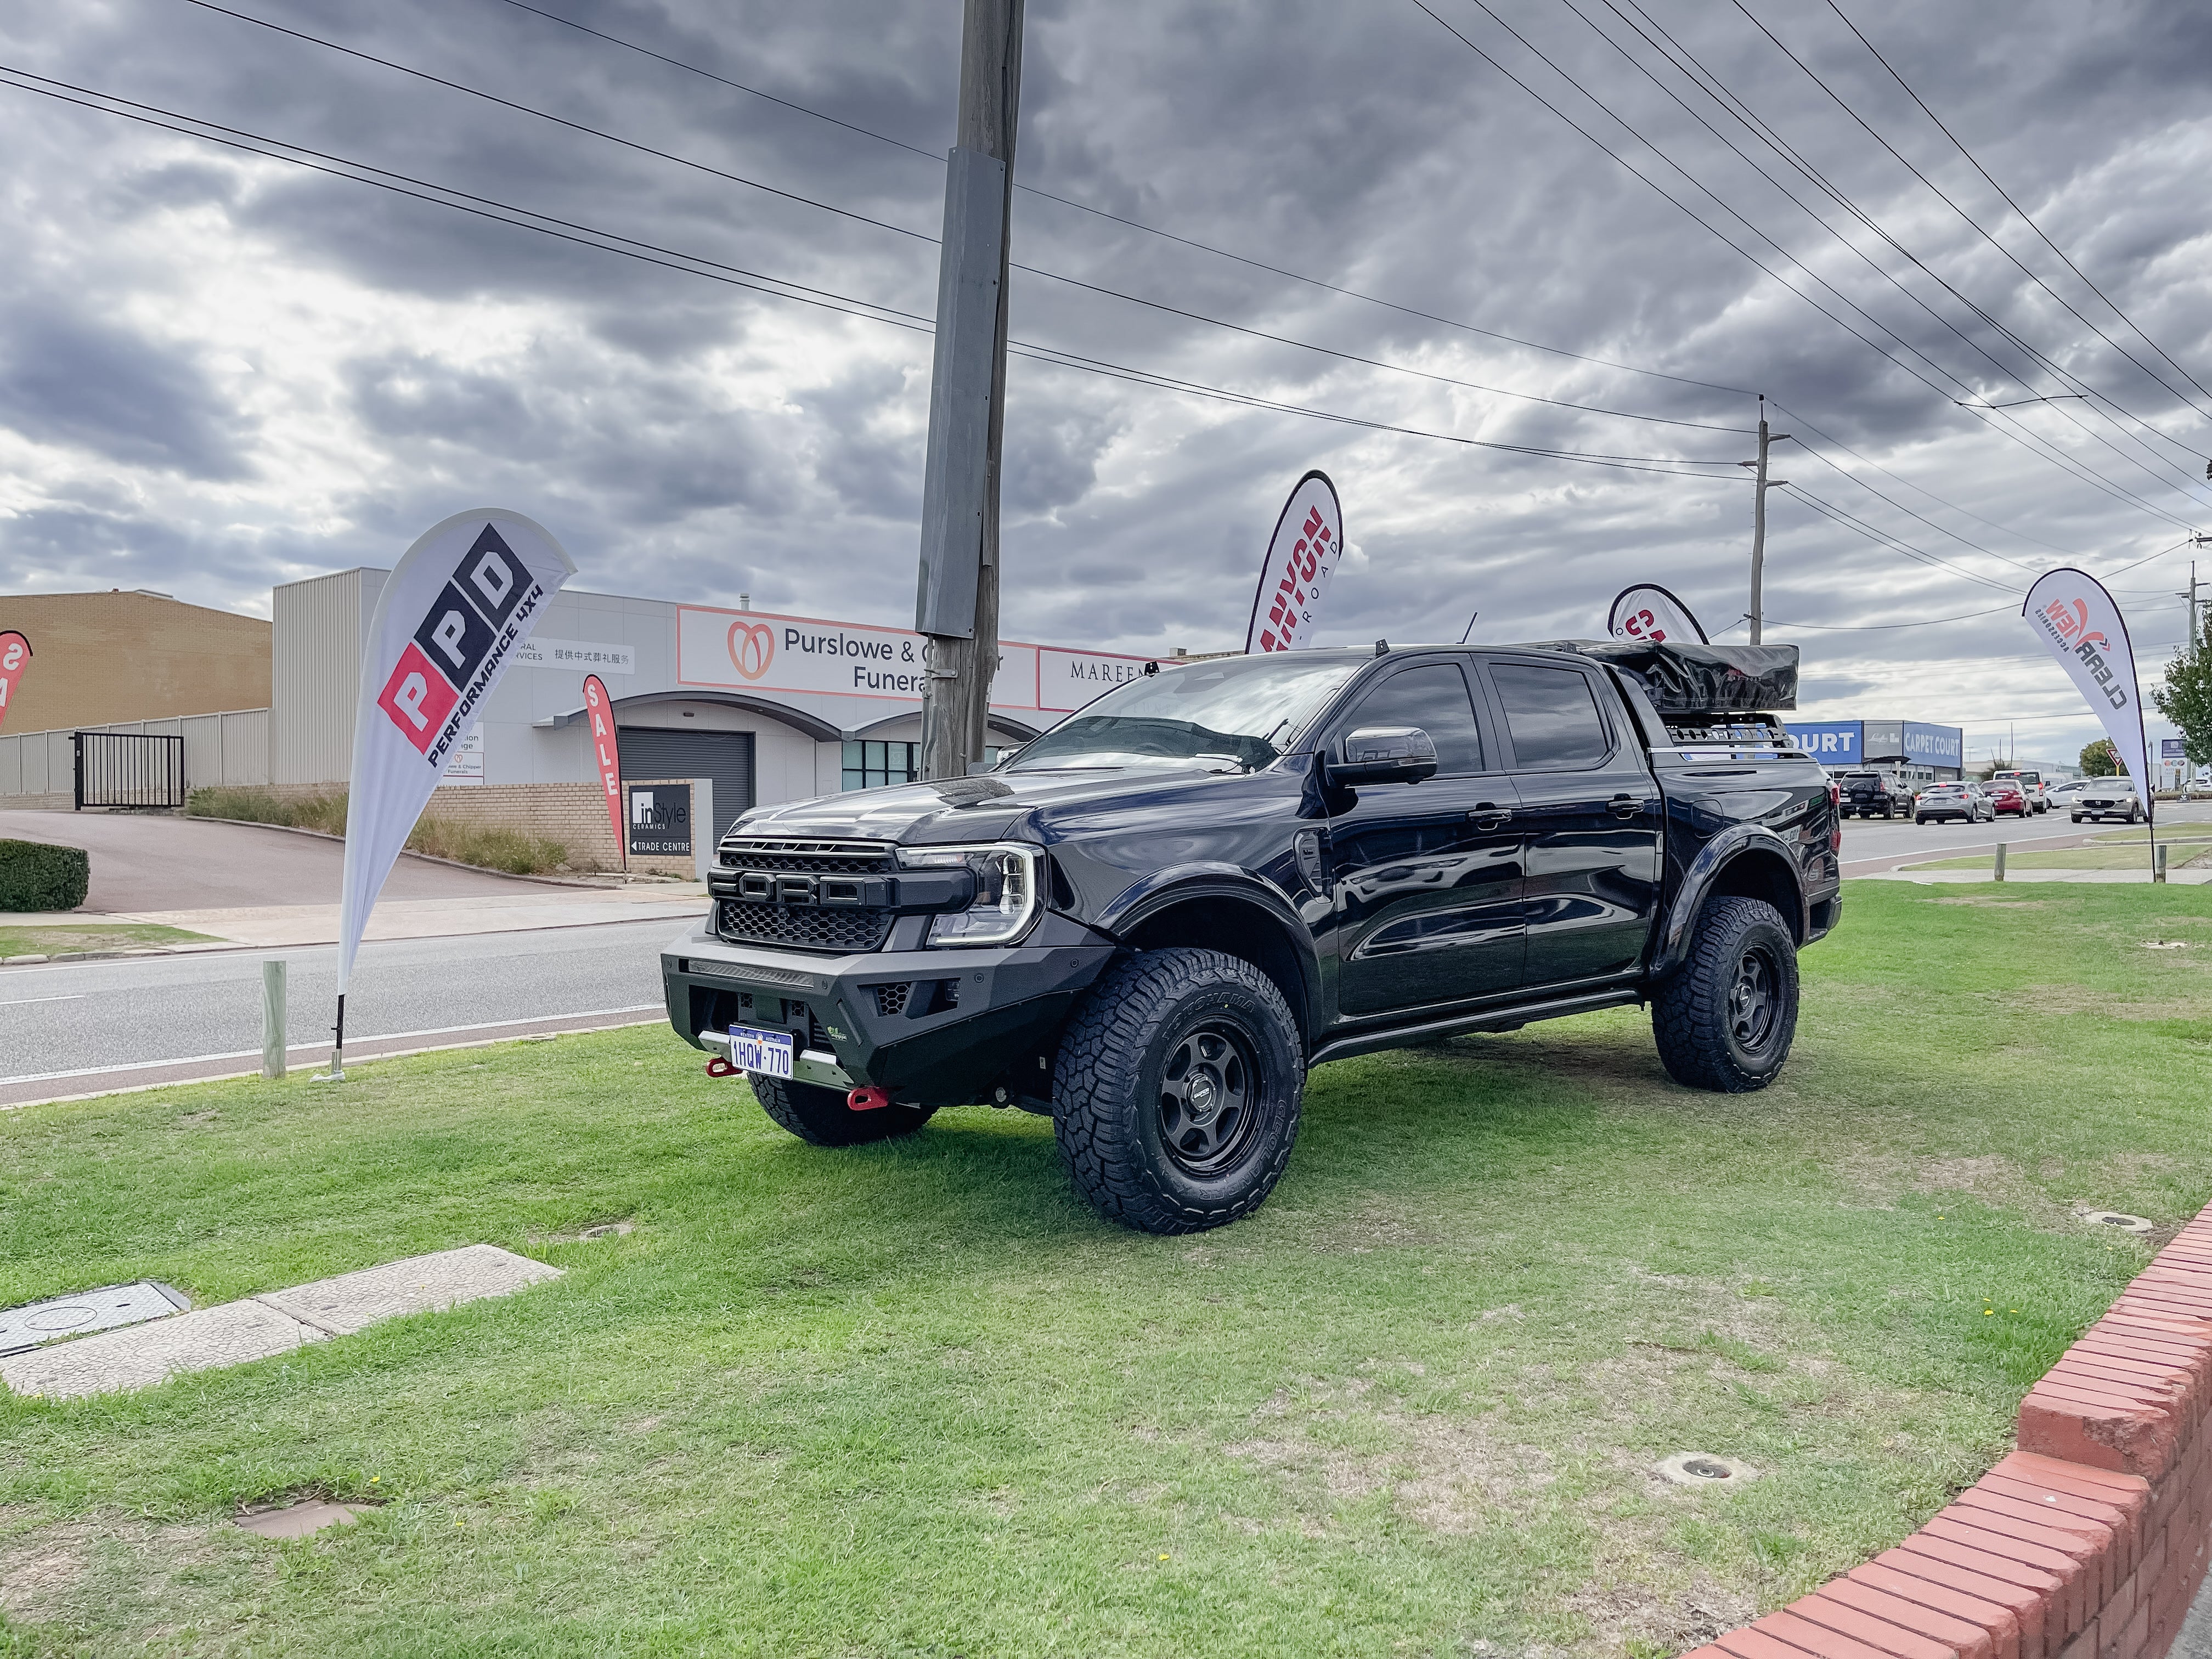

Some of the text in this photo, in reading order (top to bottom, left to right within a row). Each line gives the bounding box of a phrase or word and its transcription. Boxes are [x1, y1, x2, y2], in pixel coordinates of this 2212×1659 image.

[1260, 504, 1331, 652] ANYON
[393, 551, 514, 732] PPD
[428, 623, 518, 768] PERFORMANCE
[785, 628, 893, 661] Purslowe
[901, 641, 915, 663] &
[587, 684, 619, 796] SALE
[1905, 732, 1934, 754] CARPET
[1935, 736, 1960, 757] COURT
[638, 842, 690, 851] TRADE CENTRE
